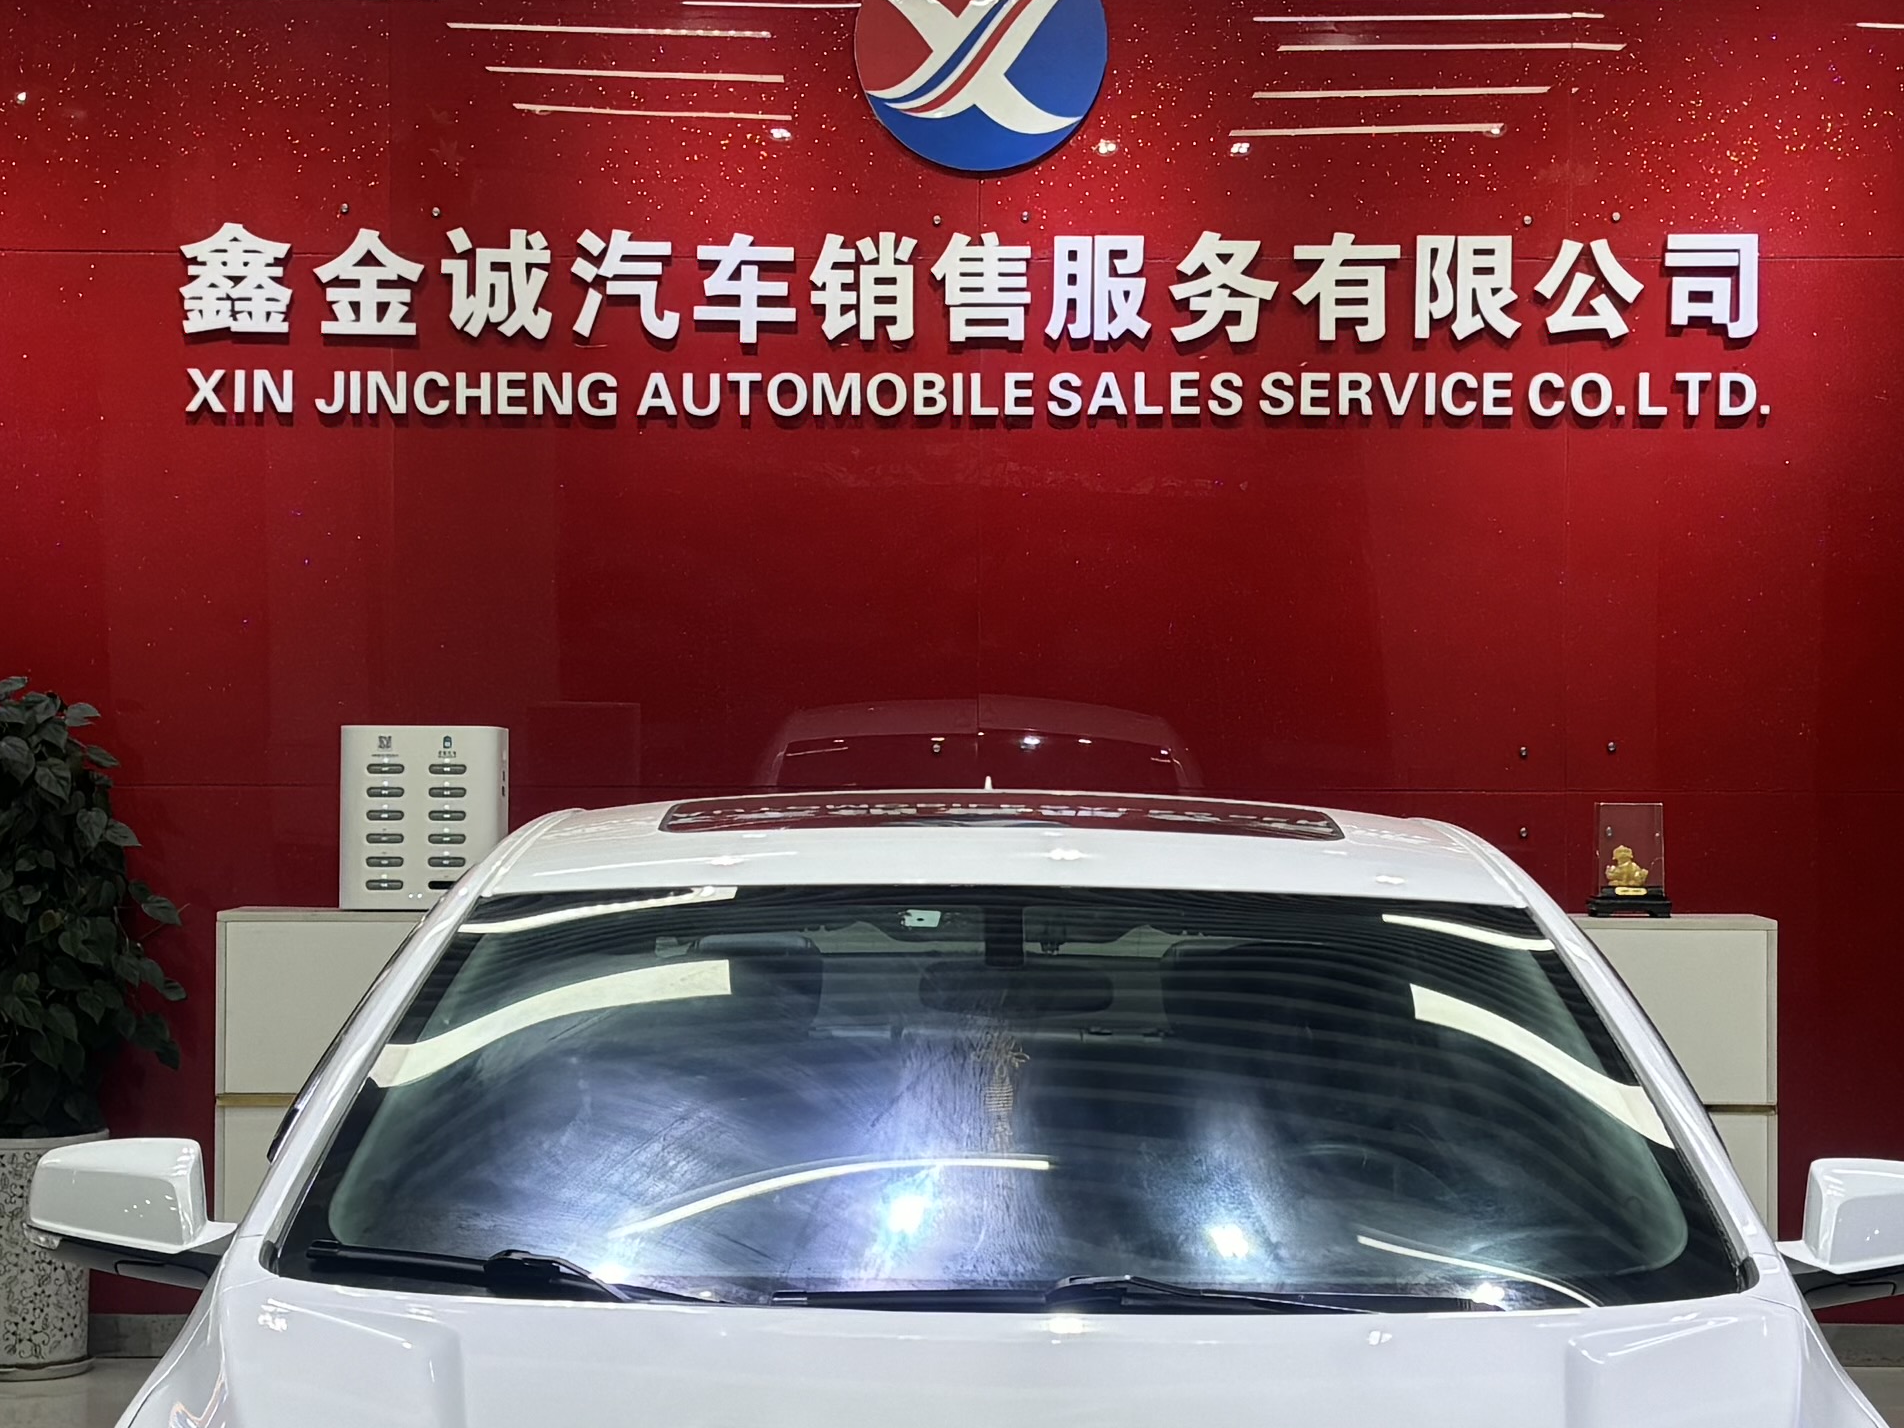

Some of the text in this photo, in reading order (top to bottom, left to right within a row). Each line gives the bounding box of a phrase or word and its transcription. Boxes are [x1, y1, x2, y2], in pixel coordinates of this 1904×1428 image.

[180, 222, 1760, 344] 鑫金诚汽车销售服务有限公司
[185, 368, 294, 415] XIN
[314, 370, 619, 417] JINCHENG
[636, 371, 1035, 417] AUTOMOBILE
[1046, 371, 1244, 417] SALES
[1259, 371, 1514, 417] SERVICE
